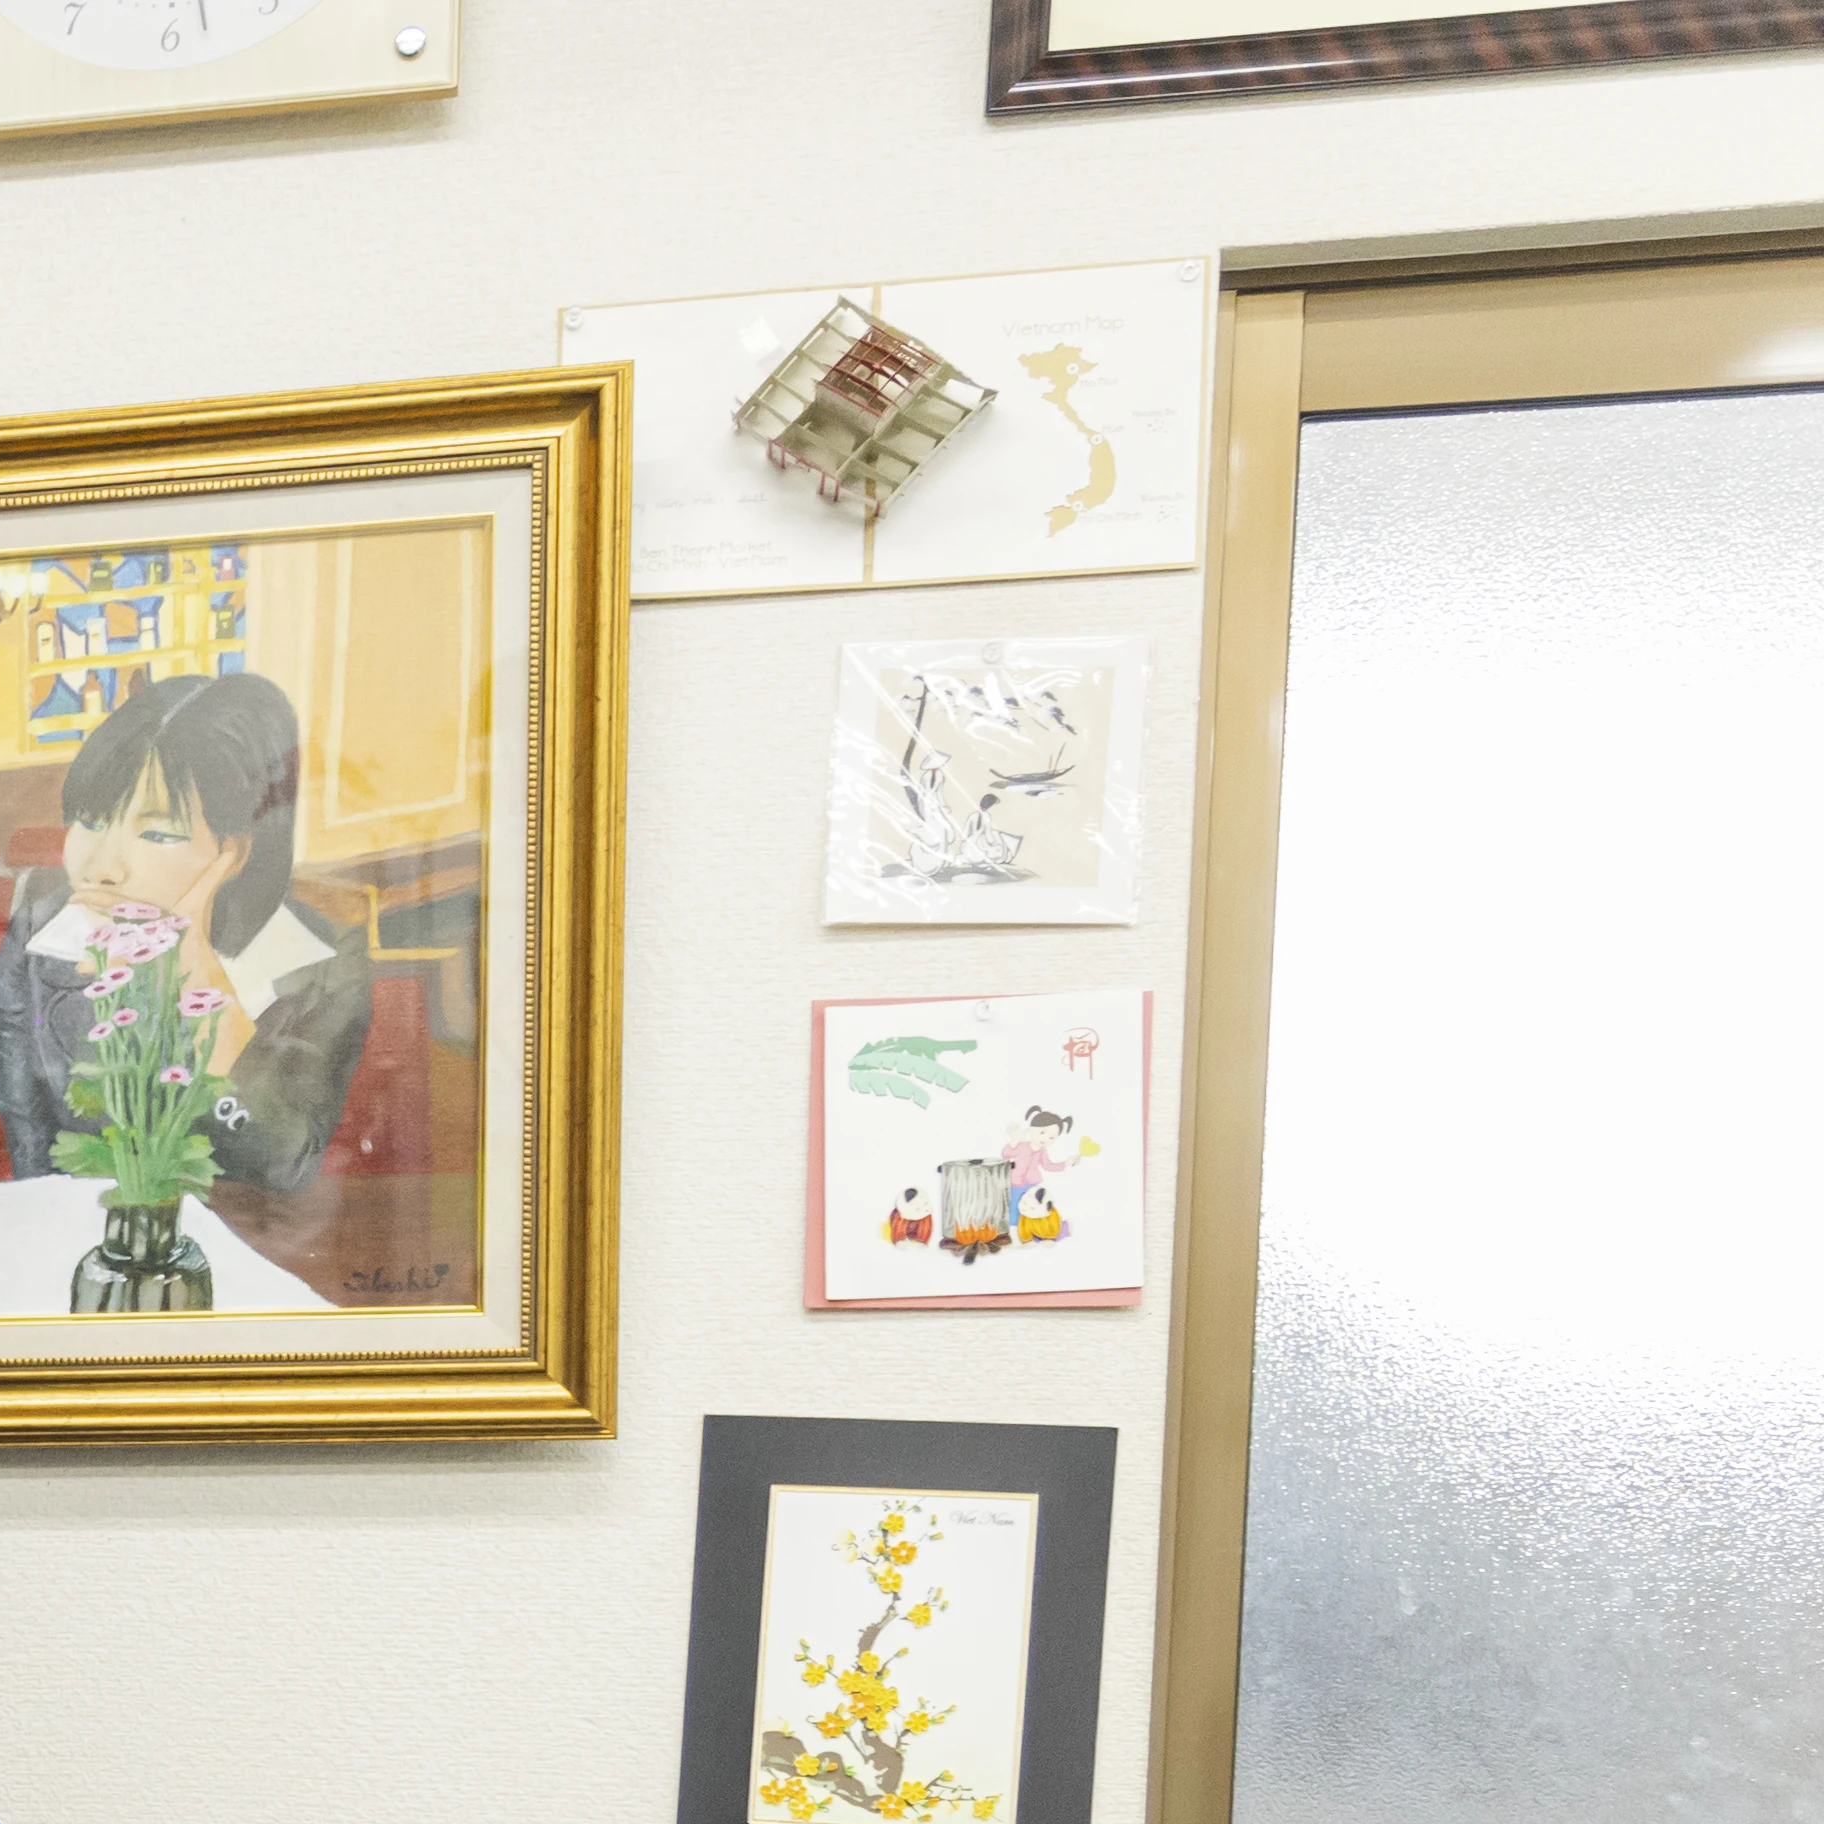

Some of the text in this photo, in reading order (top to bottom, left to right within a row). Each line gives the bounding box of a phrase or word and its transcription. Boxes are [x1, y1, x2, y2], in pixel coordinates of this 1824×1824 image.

[161, 18, 180, 52] 6
[1002, 316, 1124, 338] Vietnam Map
